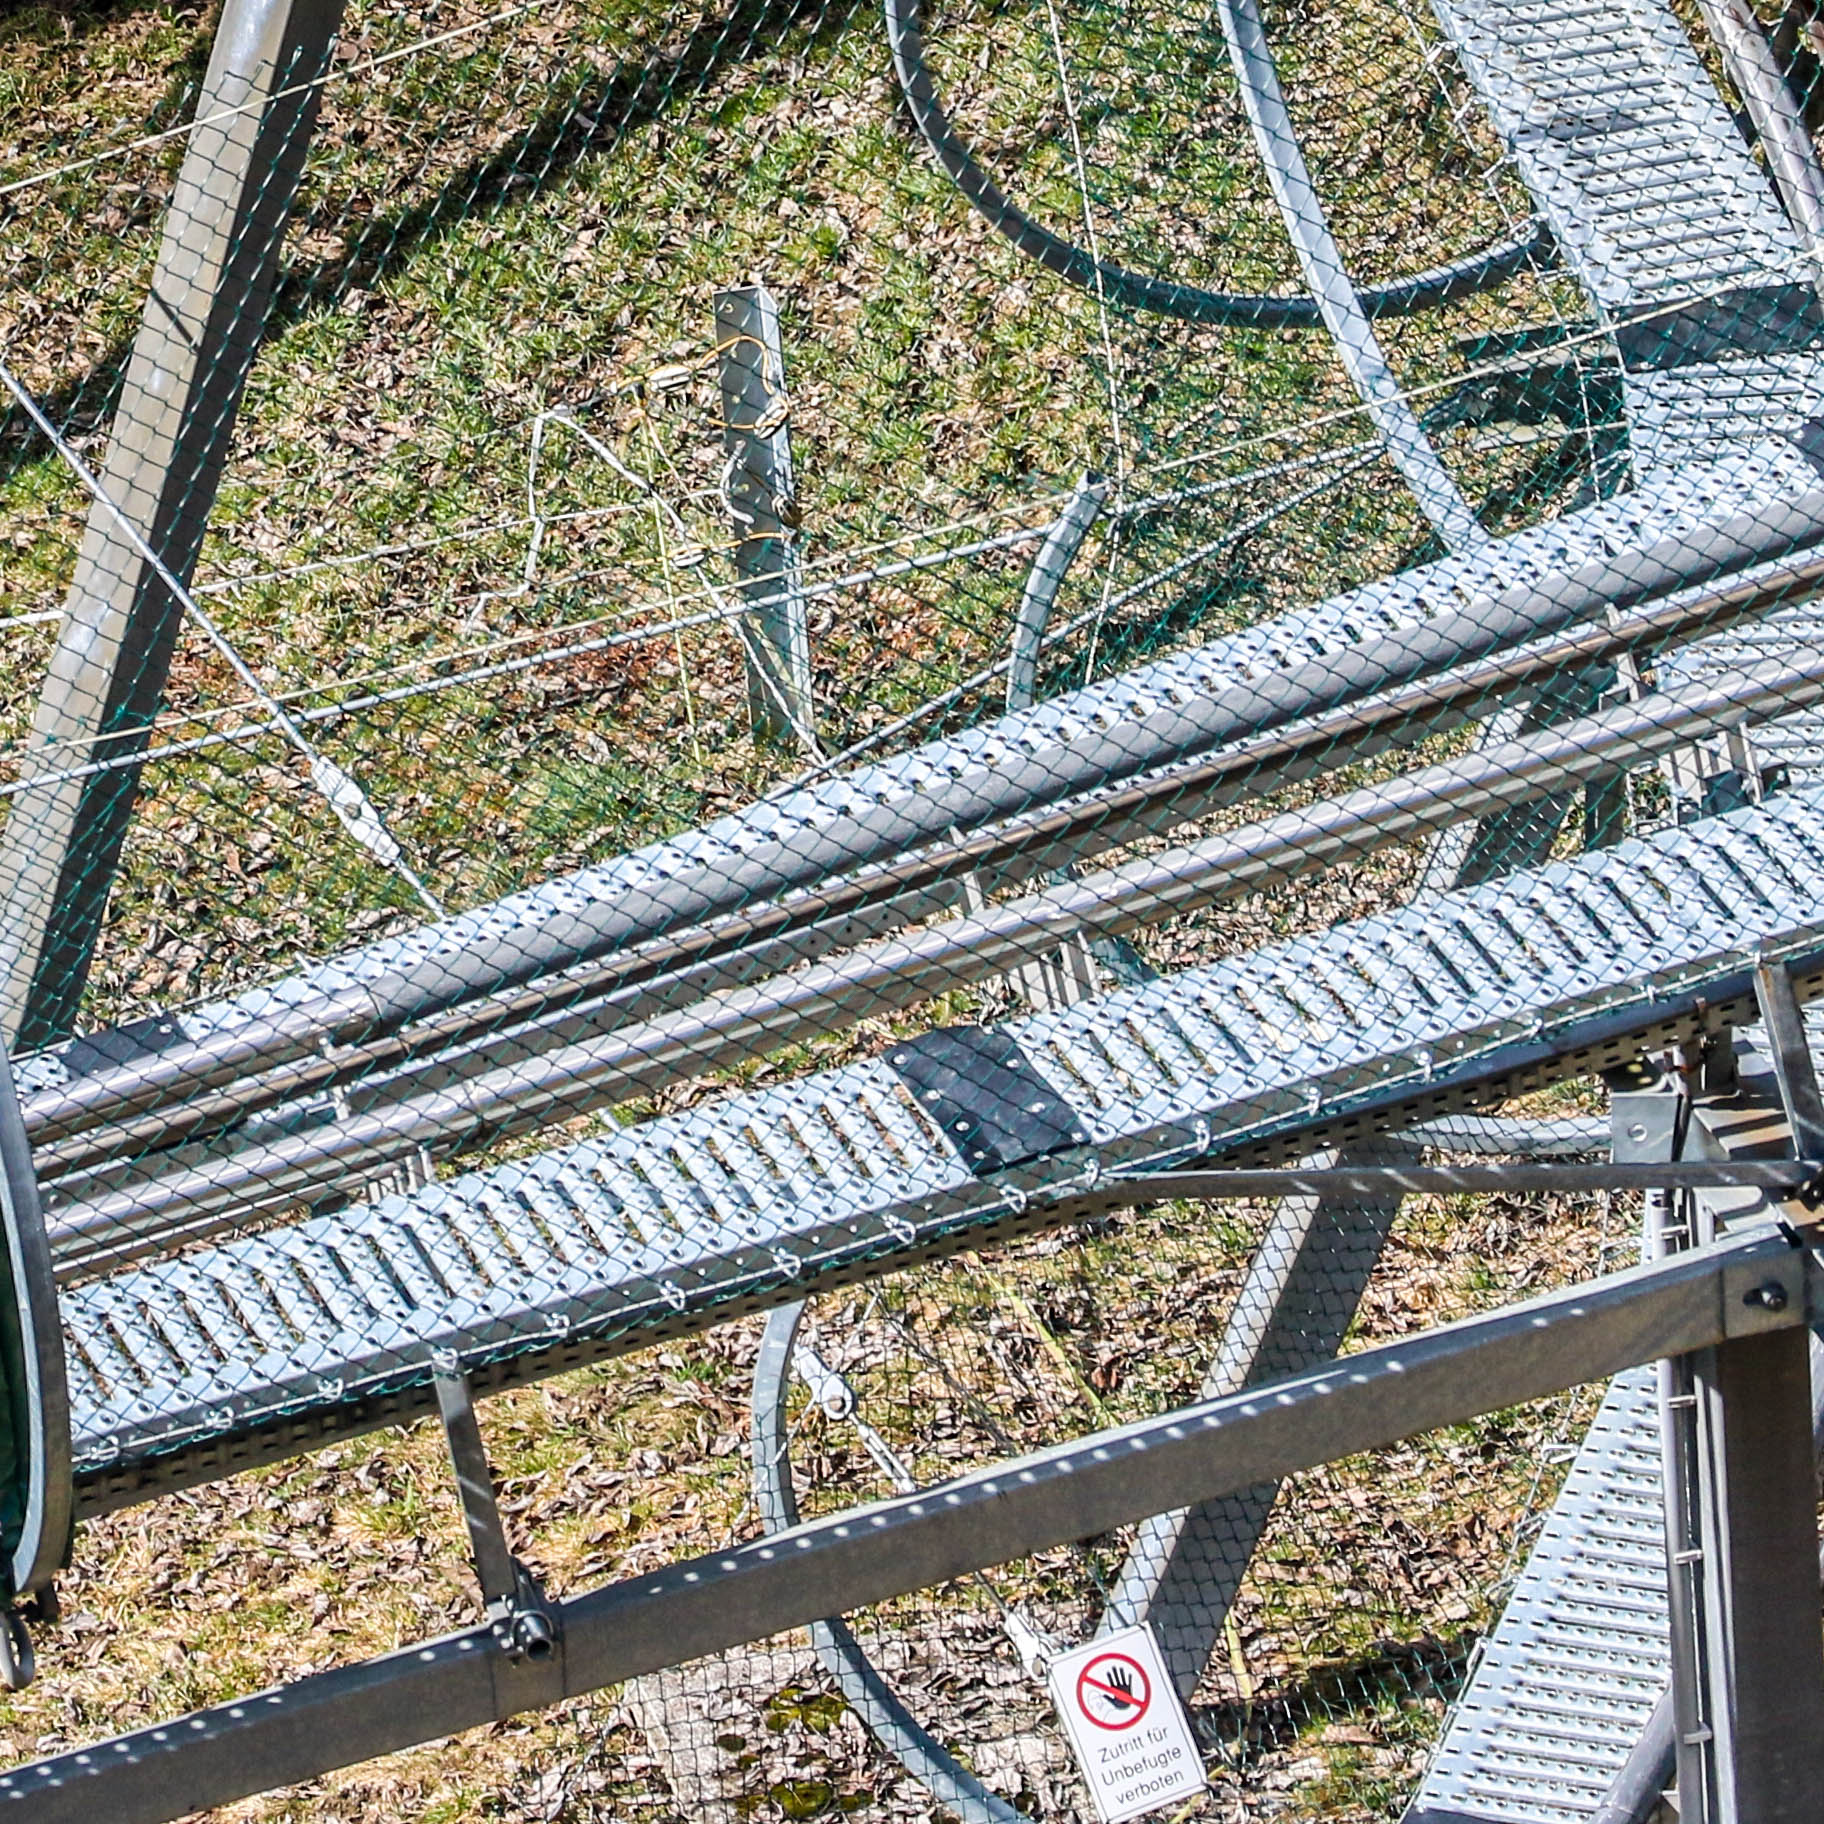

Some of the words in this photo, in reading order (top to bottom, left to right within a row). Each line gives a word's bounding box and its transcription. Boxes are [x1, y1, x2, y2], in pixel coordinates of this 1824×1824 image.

[1098, 1736, 1144, 1763] Zutritt
[1146, 1726, 1169, 1745] für
[1101, 1746, 1182, 1786] Unbefugte
[1115, 1769, 1184, 1805] verboten
